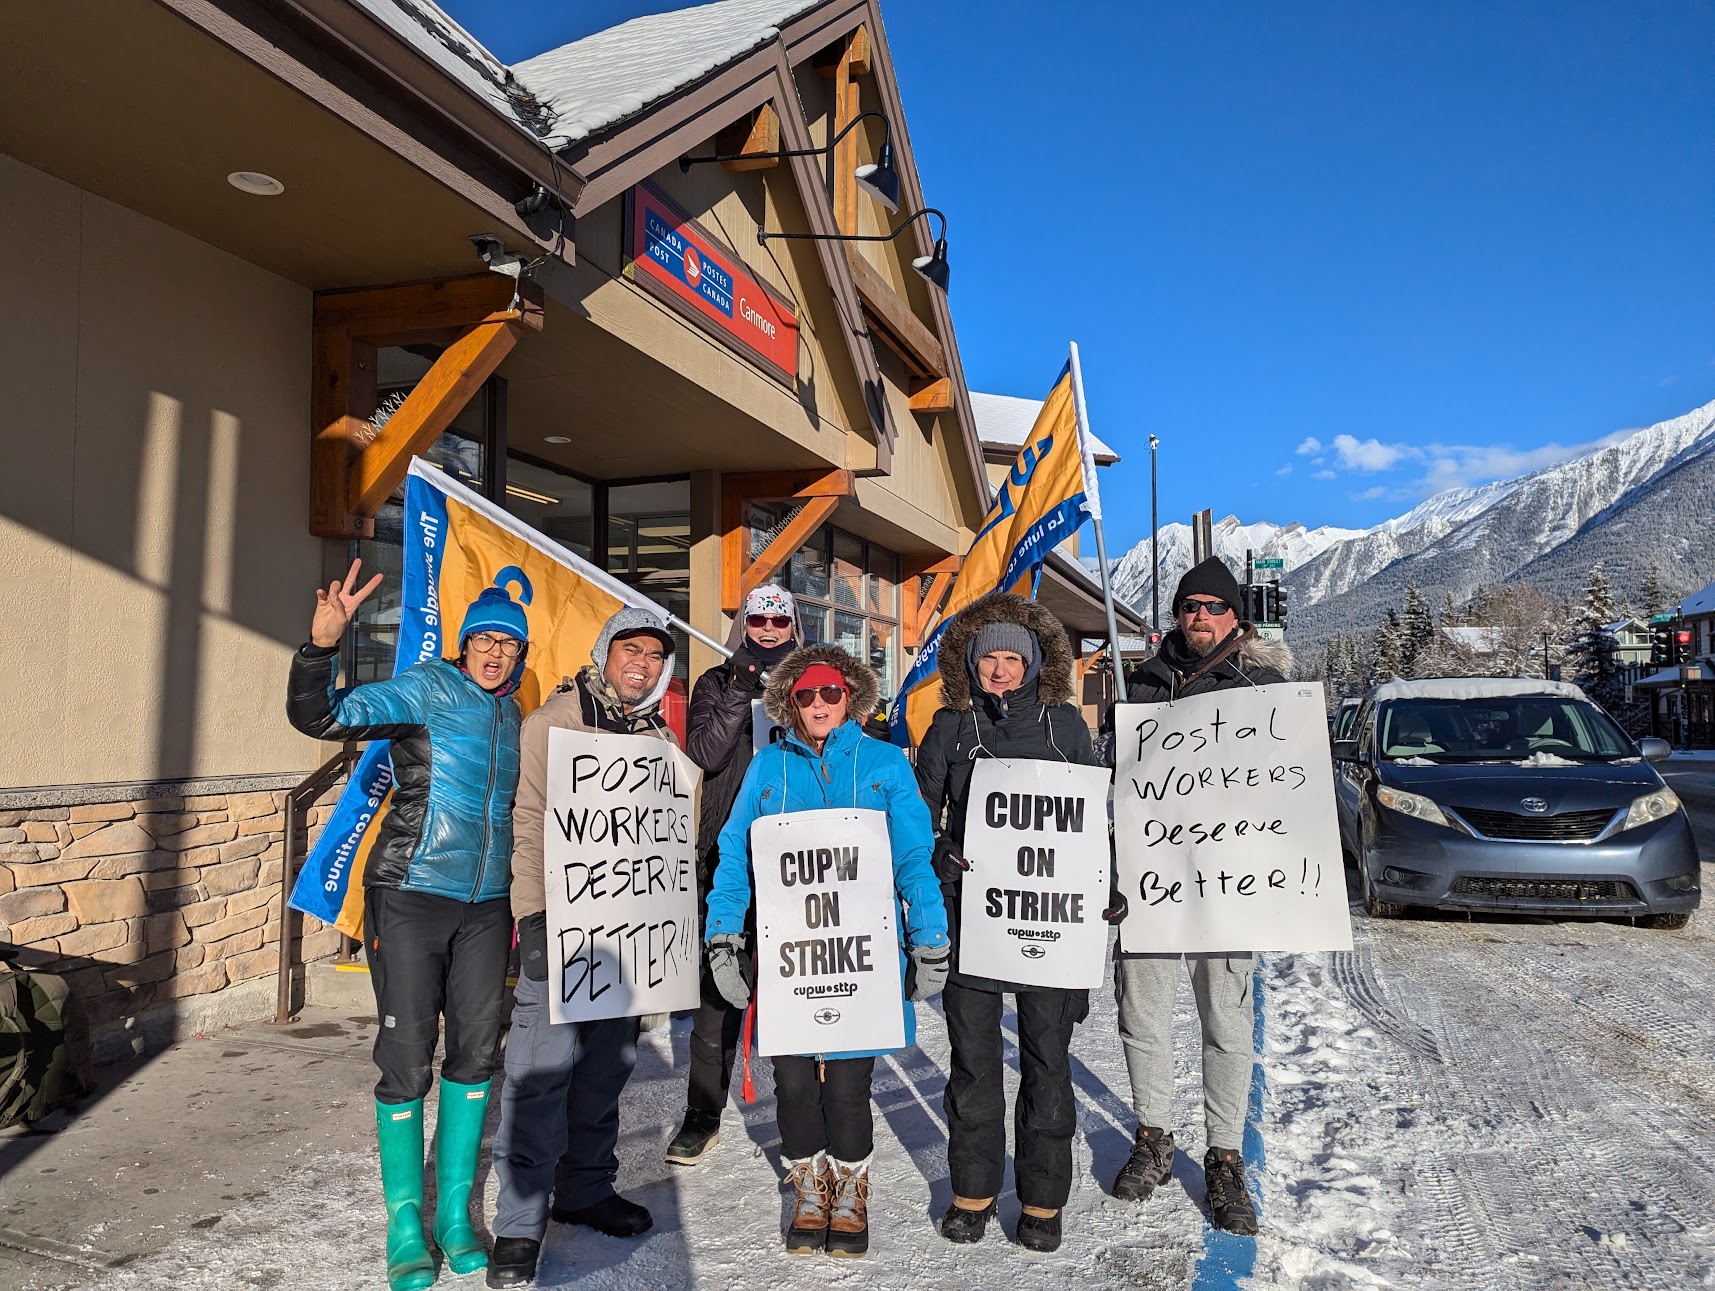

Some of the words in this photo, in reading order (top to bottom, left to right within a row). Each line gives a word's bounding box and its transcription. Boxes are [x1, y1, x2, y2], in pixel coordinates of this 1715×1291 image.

[650, 219, 682, 252] CANADA
[650, 241, 670, 264] POST
[703, 261, 728, 288] POSTES
[702, 283, 730, 311] CANADA
[739, 298, 776, 340] Canmore
[1136, 707, 1286, 762] Postal
[573, 754, 689, 799] POSTAL
[1131, 766, 1306, 801] WORKERS
[553, 804, 689, 846] WORKERS
[985, 791, 1085, 833] CUPW
[564, 855, 689, 904] DESERVE
[779, 846, 859, 887] CUPW
[1017, 846, 1055, 878] ON
[804, 891, 840, 930] ON
[985, 887, 1084, 924] STRIKE
[557, 917, 695, 1004] BETTER!!!
[779, 934, 873, 978] STRIKE
